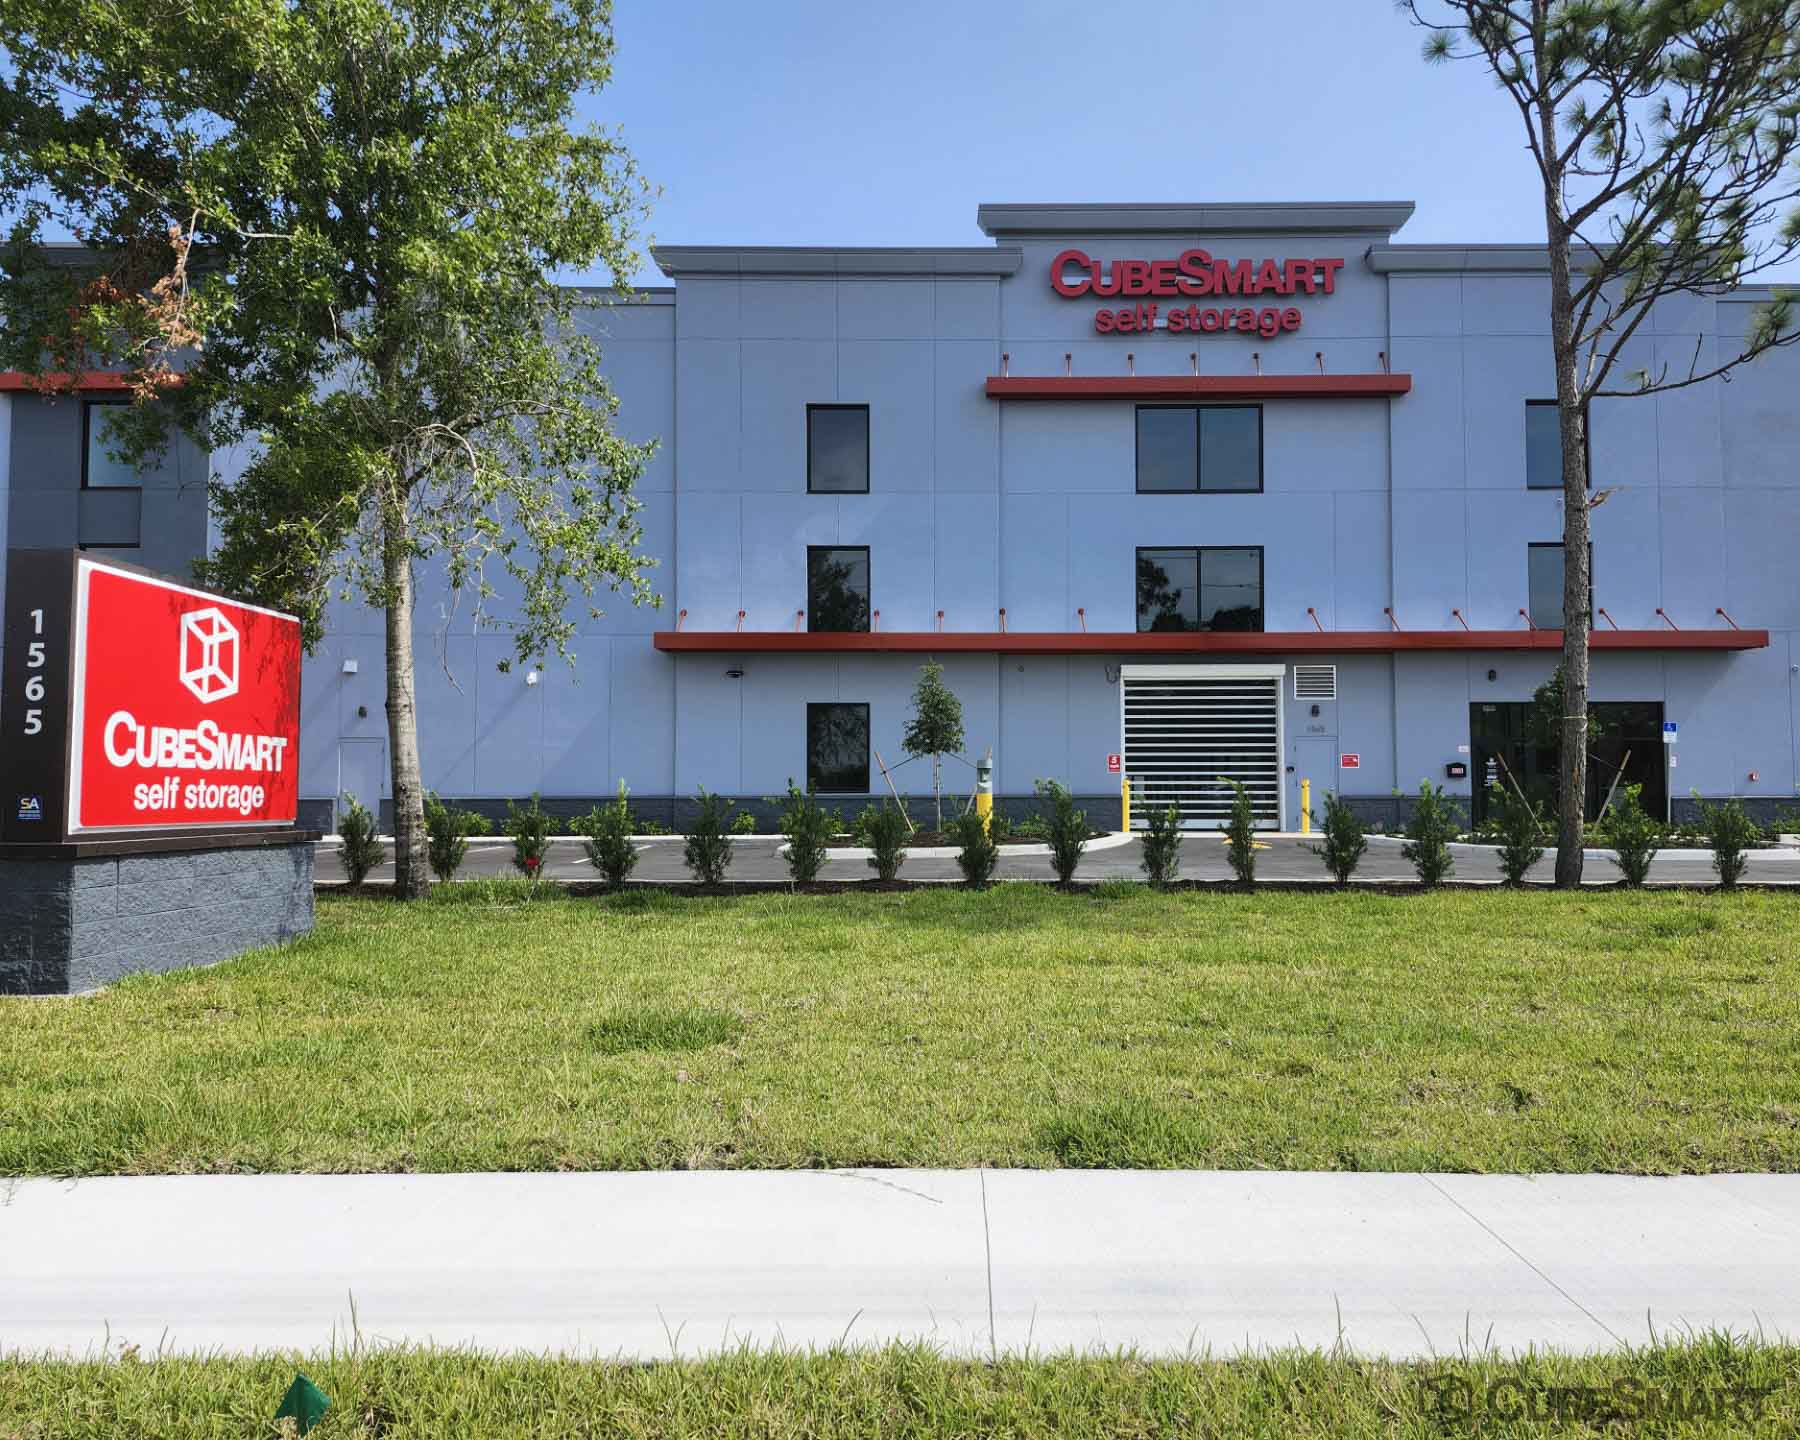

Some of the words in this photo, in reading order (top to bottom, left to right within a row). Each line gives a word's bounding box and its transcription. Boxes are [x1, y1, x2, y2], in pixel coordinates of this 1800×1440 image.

[1094, 303, 1158, 333] self
[1166, 303, 1302, 338] storage
[24, 608, 46, 735] 1565
[133, 776, 180, 811] self
[184, 778, 265, 816] storage
